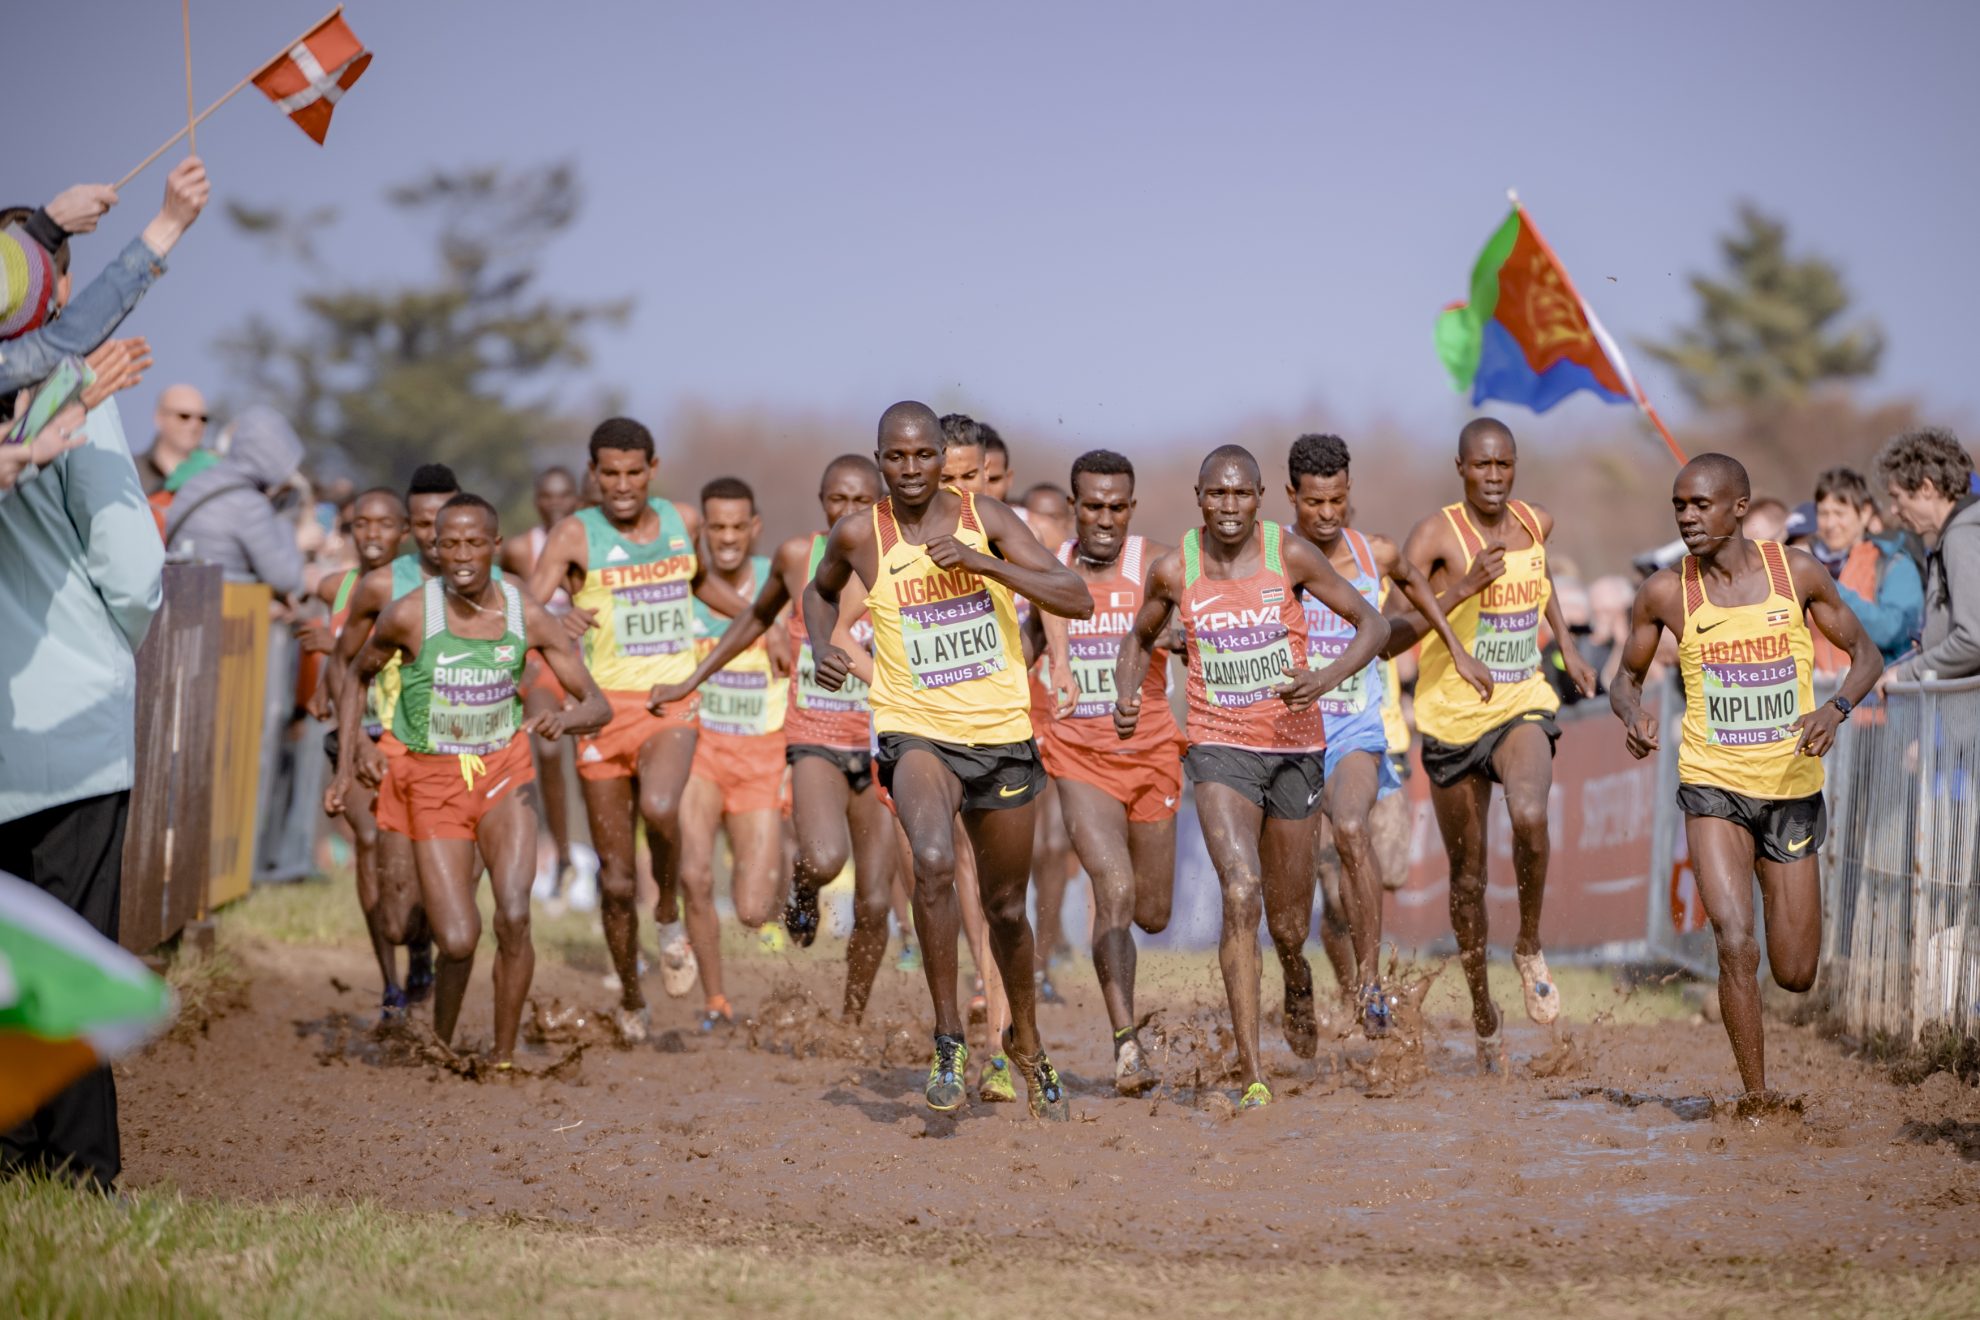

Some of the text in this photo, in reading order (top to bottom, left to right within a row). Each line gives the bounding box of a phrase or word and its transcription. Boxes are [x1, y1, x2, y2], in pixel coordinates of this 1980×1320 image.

[894, 566, 987, 607] UGANDA
[625, 608, 685, 636] FUFA
[1192, 606, 1281, 632] KENYA
[911, 621, 997, 667] J. AYEKO
[1700, 633, 1791, 664] UGANDA
[918, 667, 973, 687] AARHUS
[1705, 663, 1795, 682] Mikkeller
[1212, 690, 1263, 706] AARHUS
[1708, 689, 1794, 723] KIPLIMO
[1711, 731, 1767, 744] AARHUS
